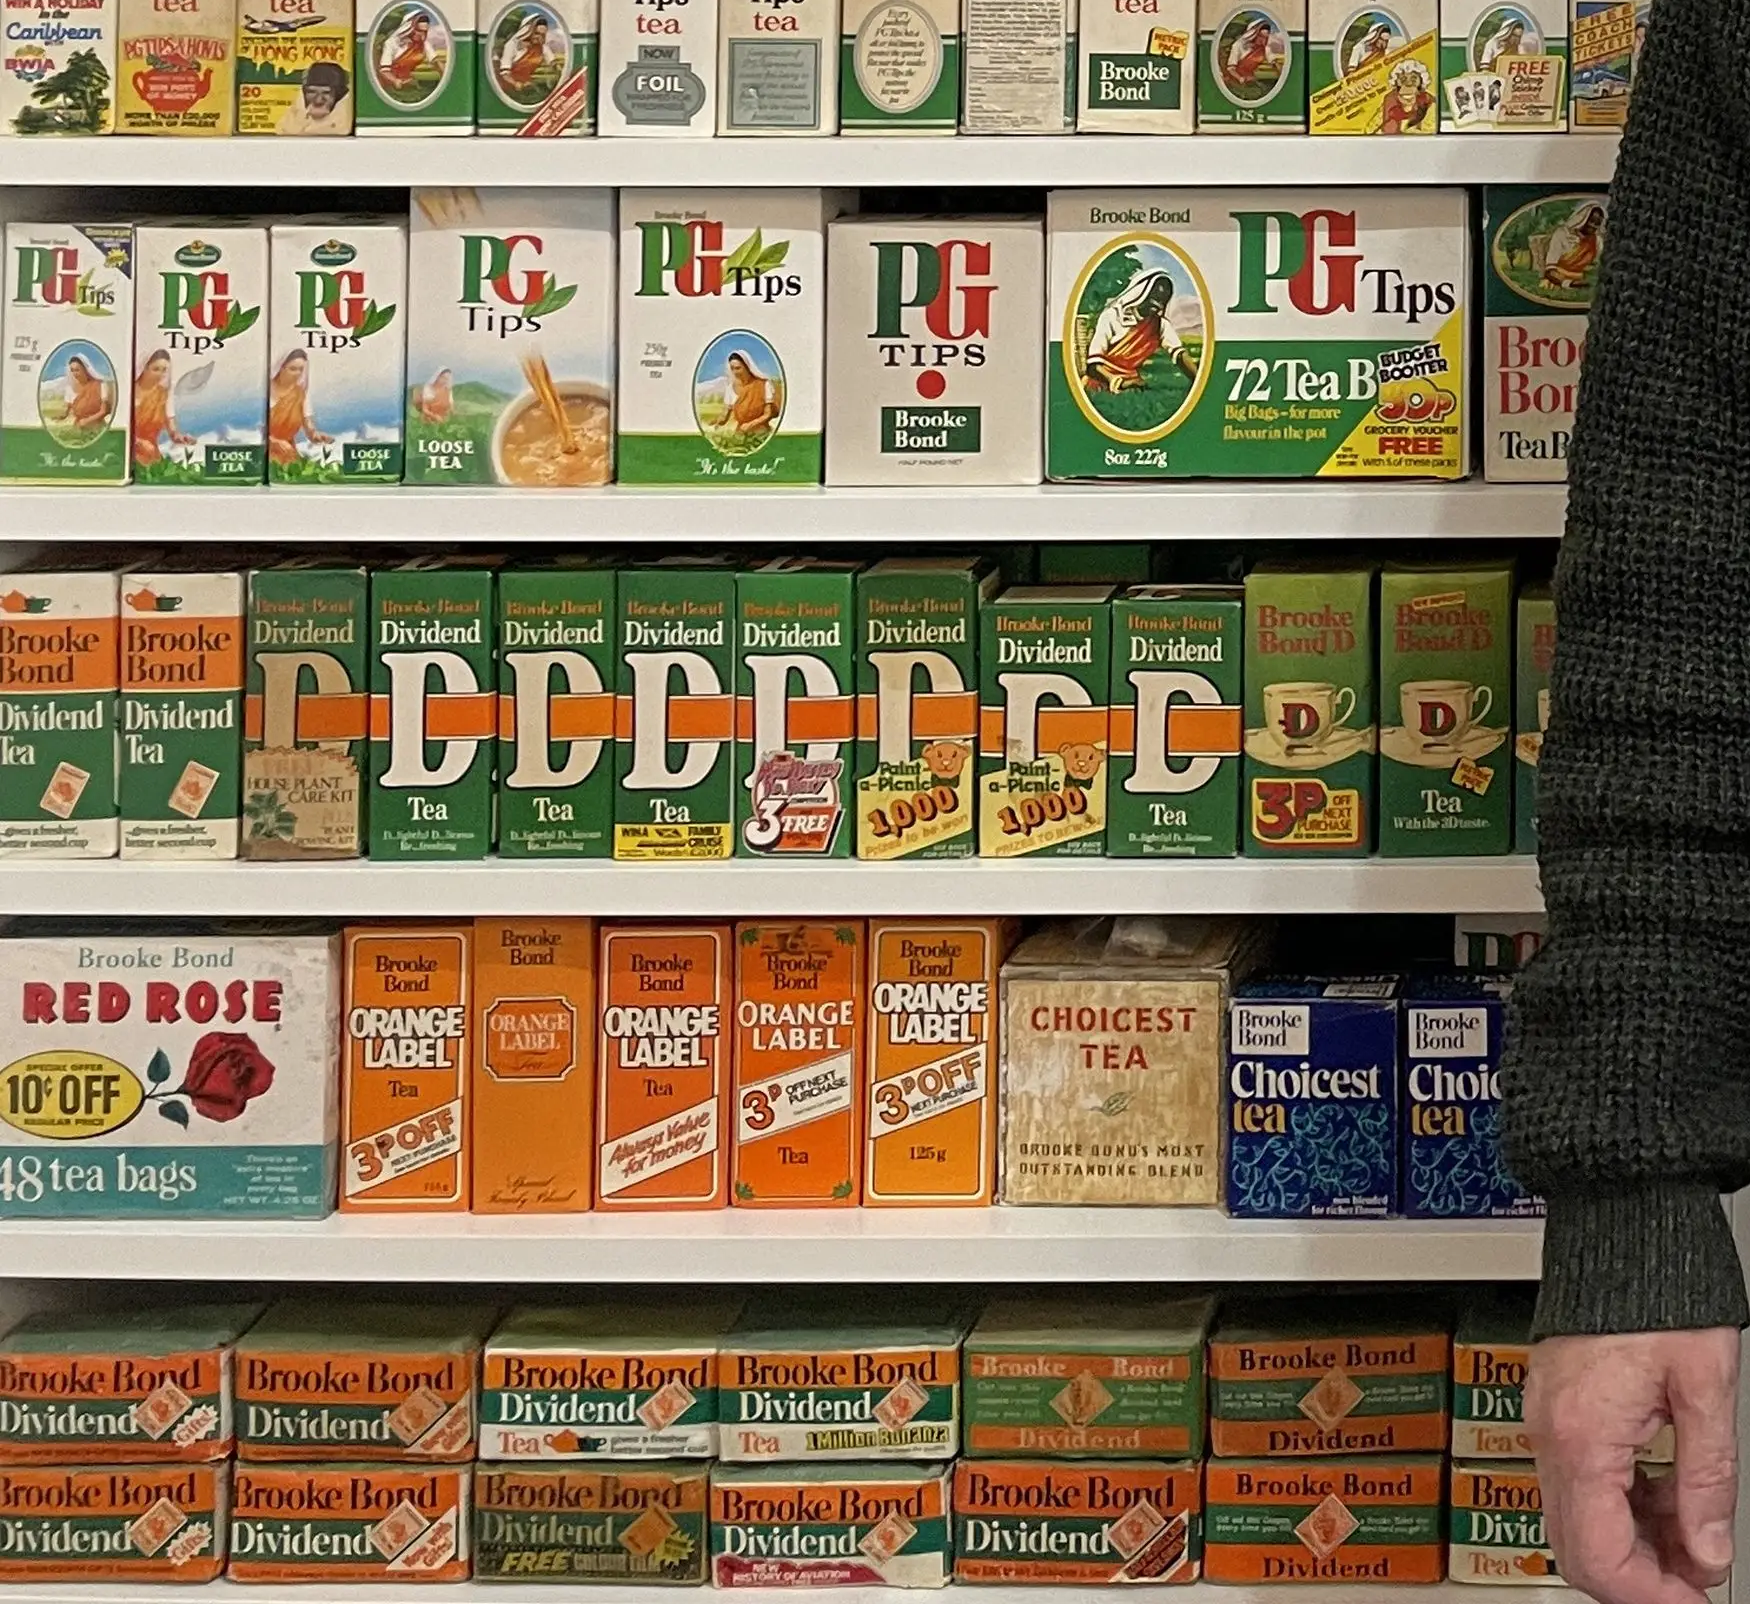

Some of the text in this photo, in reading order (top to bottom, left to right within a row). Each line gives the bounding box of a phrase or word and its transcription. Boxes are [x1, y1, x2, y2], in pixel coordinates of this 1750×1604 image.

[6, 21, 103, 42] Caribbean
[302, 44, 345, 62] KONG
[1100, 62, 1169, 84] Brooke
[1507, 60, 1550, 75] FREE
[1100, 82, 1151, 102] Bond
[1090, 207, 1190, 225] Brooke Bond
[636, 222, 724, 297] PG
[728, 267, 802, 301] Tips
[1363, 269, 1455, 324] Tips
[1226, 359, 1336, 400] 72 Tea
[1224, 404, 1282, 423] Big Bags
[212, 450, 253, 461] LOOSE
[418, 439, 475, 456] LOOSE
[1379, 437, 1443, 456] FREE
[428, 453, 463, 470] TEA
[1104, 448, 1167, 470] 8oz 227g
[126, 630, 231, 654] Brooke
[623, 621, 724, 646] Dividend
[126, 654, 204, 683] Bond
[125, 701, 233, 731] Dividend
[288, 790, 327, 803] CARE
[1332, 794, 1352, 806] OFF
[408, 797, 448, 821] Tea
[998, 787, 1088, 834] 1,000
[1322, 806, 1353, 819] NEXT
[782, 814, 830, 831] FREE
[78, 947, 233, 970] Brooke Bond
[24, 981, 283, 1025] RED ROSE
[349, 1006, 465, 1041] ORANGE
[490, 1013, 569, 1034] ORANGE
[1031, 1006, 1198, 1033] CHOICEST
[1237, 1011, 1303, 1030] Brooke
[364, 1037, 453, 1069] LABEL
[1080, 1042, 1149, 1071] TEA
[58, 1072, 121, 1113] OFF
[1231, 1060, 1382, 1101] Choicest
[667, 1111, 711, 1142] Value
[1232, 1099, 1286, 1136] tea
[397, 1108, 456, 1153] OFF
[1156, 1145, 1205, 1158] MOST
[46, 1153, 107, 1194] tea
[115, 1152, 198, 1198] bags
[1147, 1162, 1204, 1177] BLEND
[248, 1361, 455, 1395] Brooke Bond
[499, 1392, 636, 1423] Dividend
[497, 1431, 539, 1456] Tea
[502, 1546, 568, 1572] FREE
